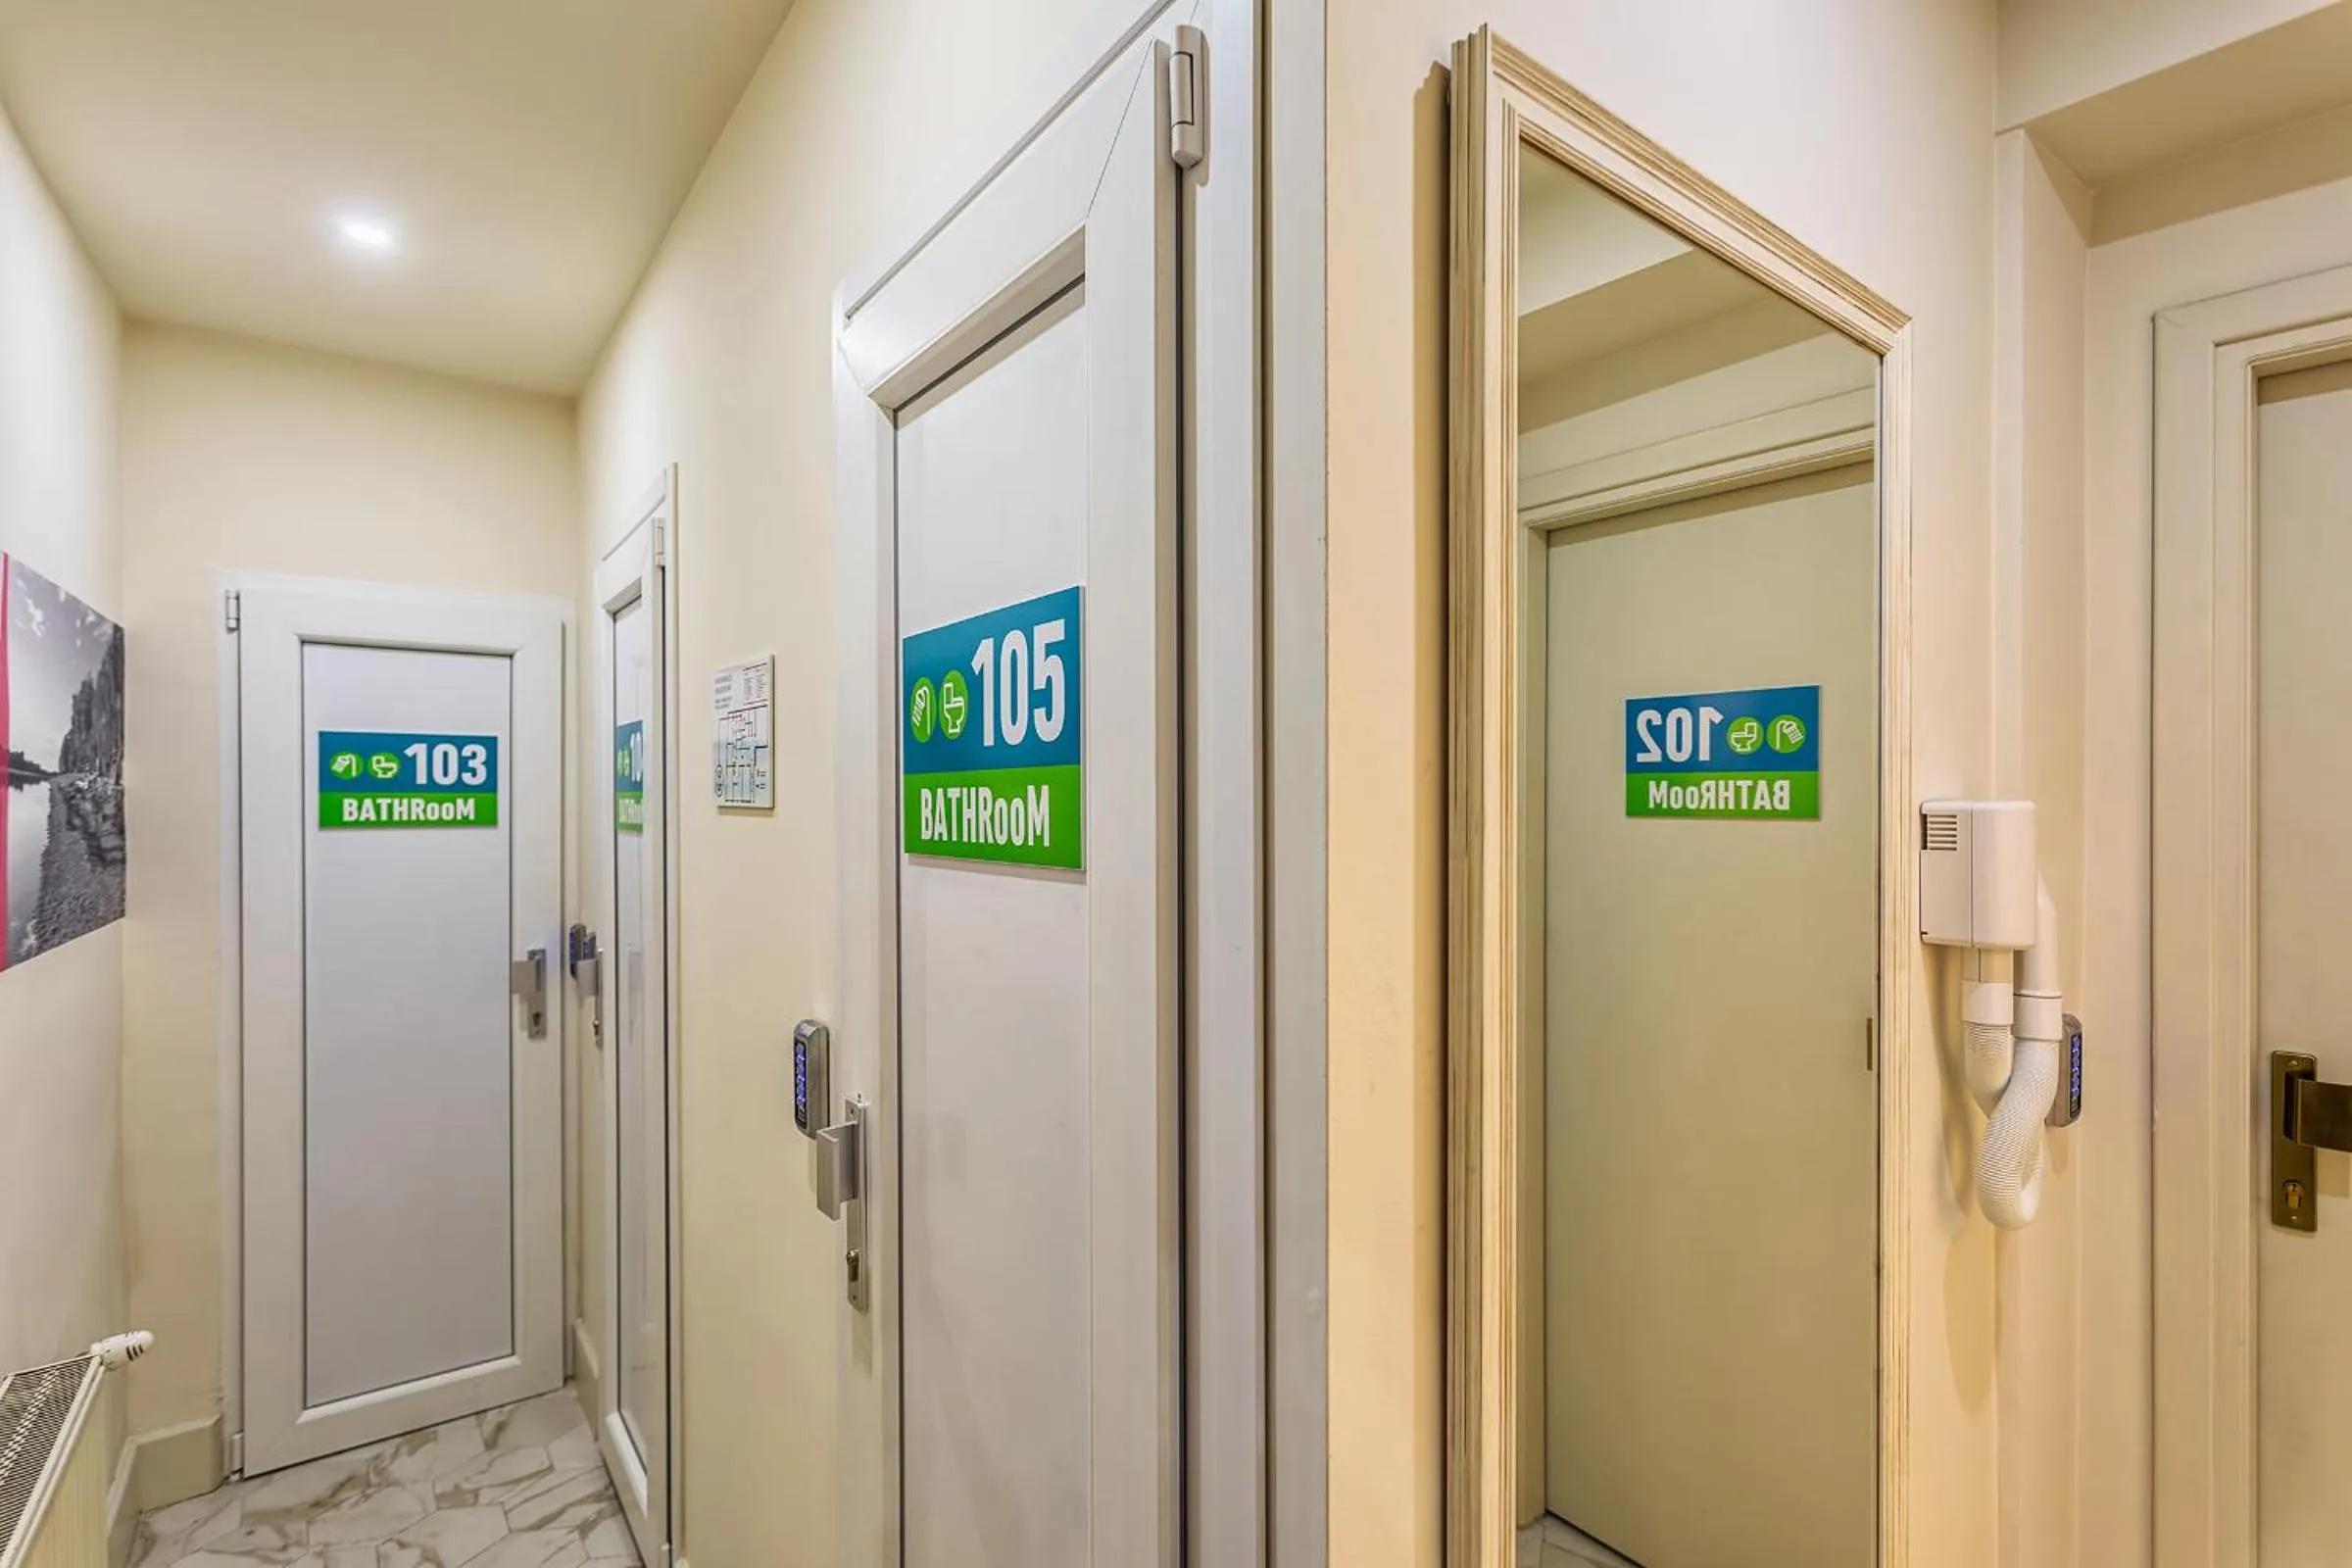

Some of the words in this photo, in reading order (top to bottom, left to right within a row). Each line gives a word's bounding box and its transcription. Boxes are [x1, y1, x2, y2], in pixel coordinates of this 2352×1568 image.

[971, 618, 1065, 747] 105
[403, 743, 487, 785] 103
[342, 798, 475, 821] BATHRooM
[920, 784, 1050, 848] BATHRooM
